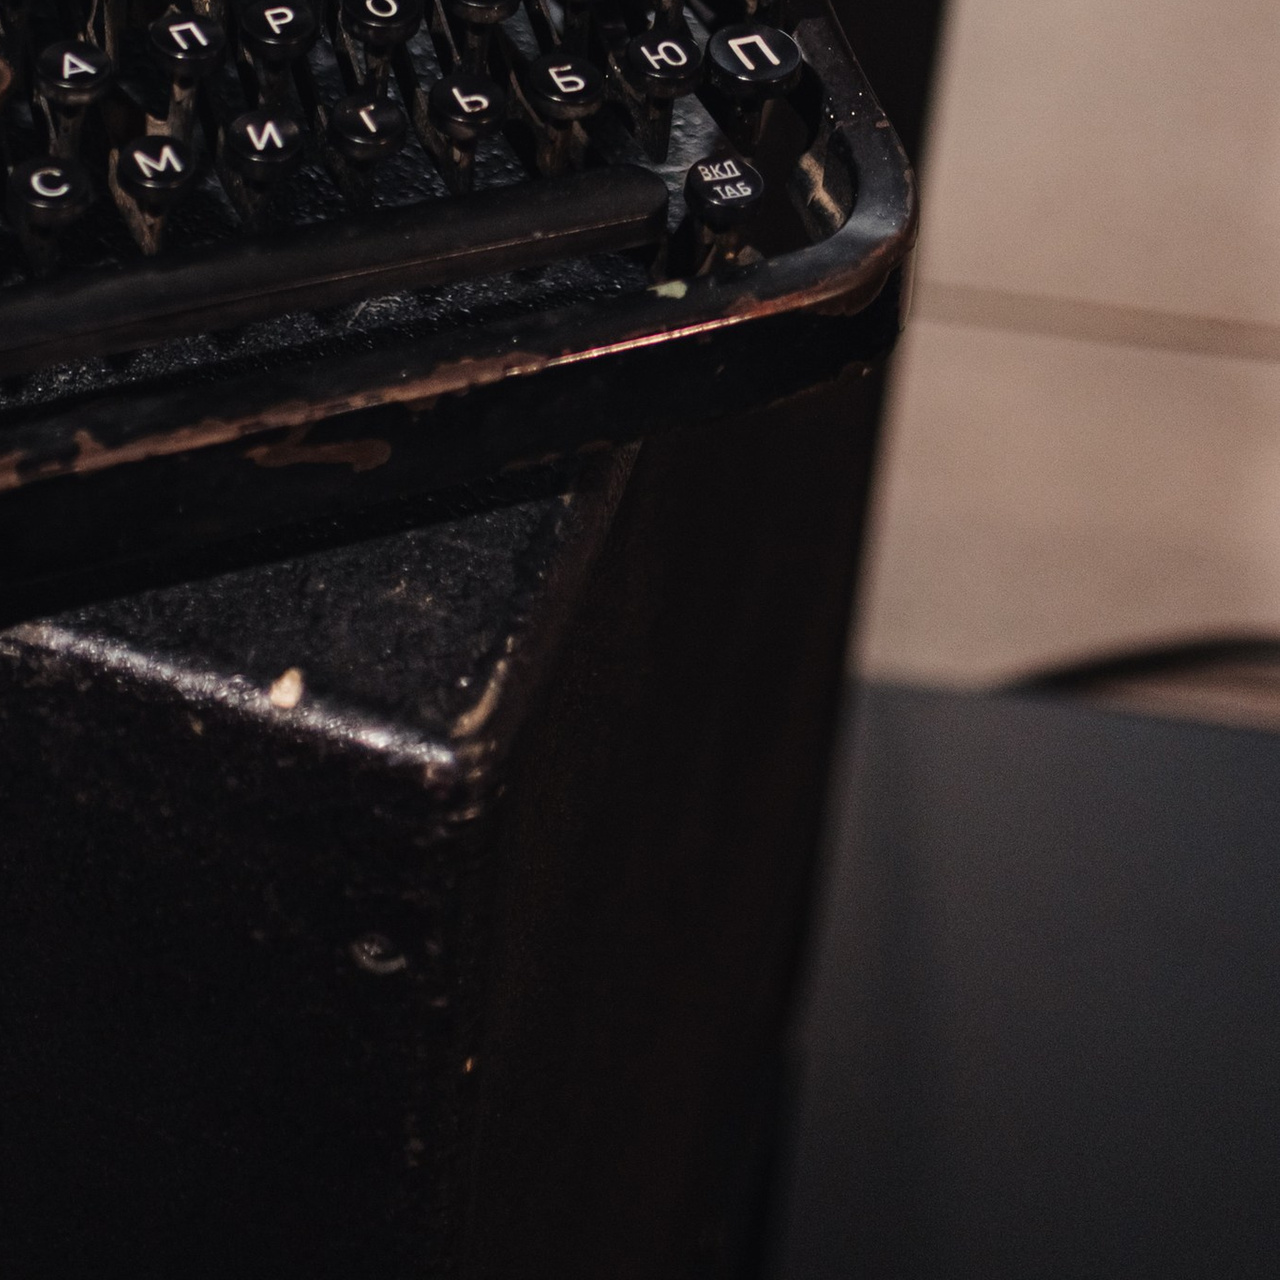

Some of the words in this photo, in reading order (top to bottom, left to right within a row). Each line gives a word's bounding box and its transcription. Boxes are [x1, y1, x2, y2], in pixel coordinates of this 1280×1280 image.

[264, 6, 294, 34] Р
[168, 21, 208, 50] П
[62, 52, 96, 79] А
[640, 41, 688, 70] Ю
[727, 34, 781, 71] П
[548, 64, 585, 93] Б
[451, 87, 489, 113] Ь
[246, 121, 283, 151] И
[133, 145, 182, 178] М
[697, 160, 742, 182] ВКЛ
[30, 169, 69, 197] С
